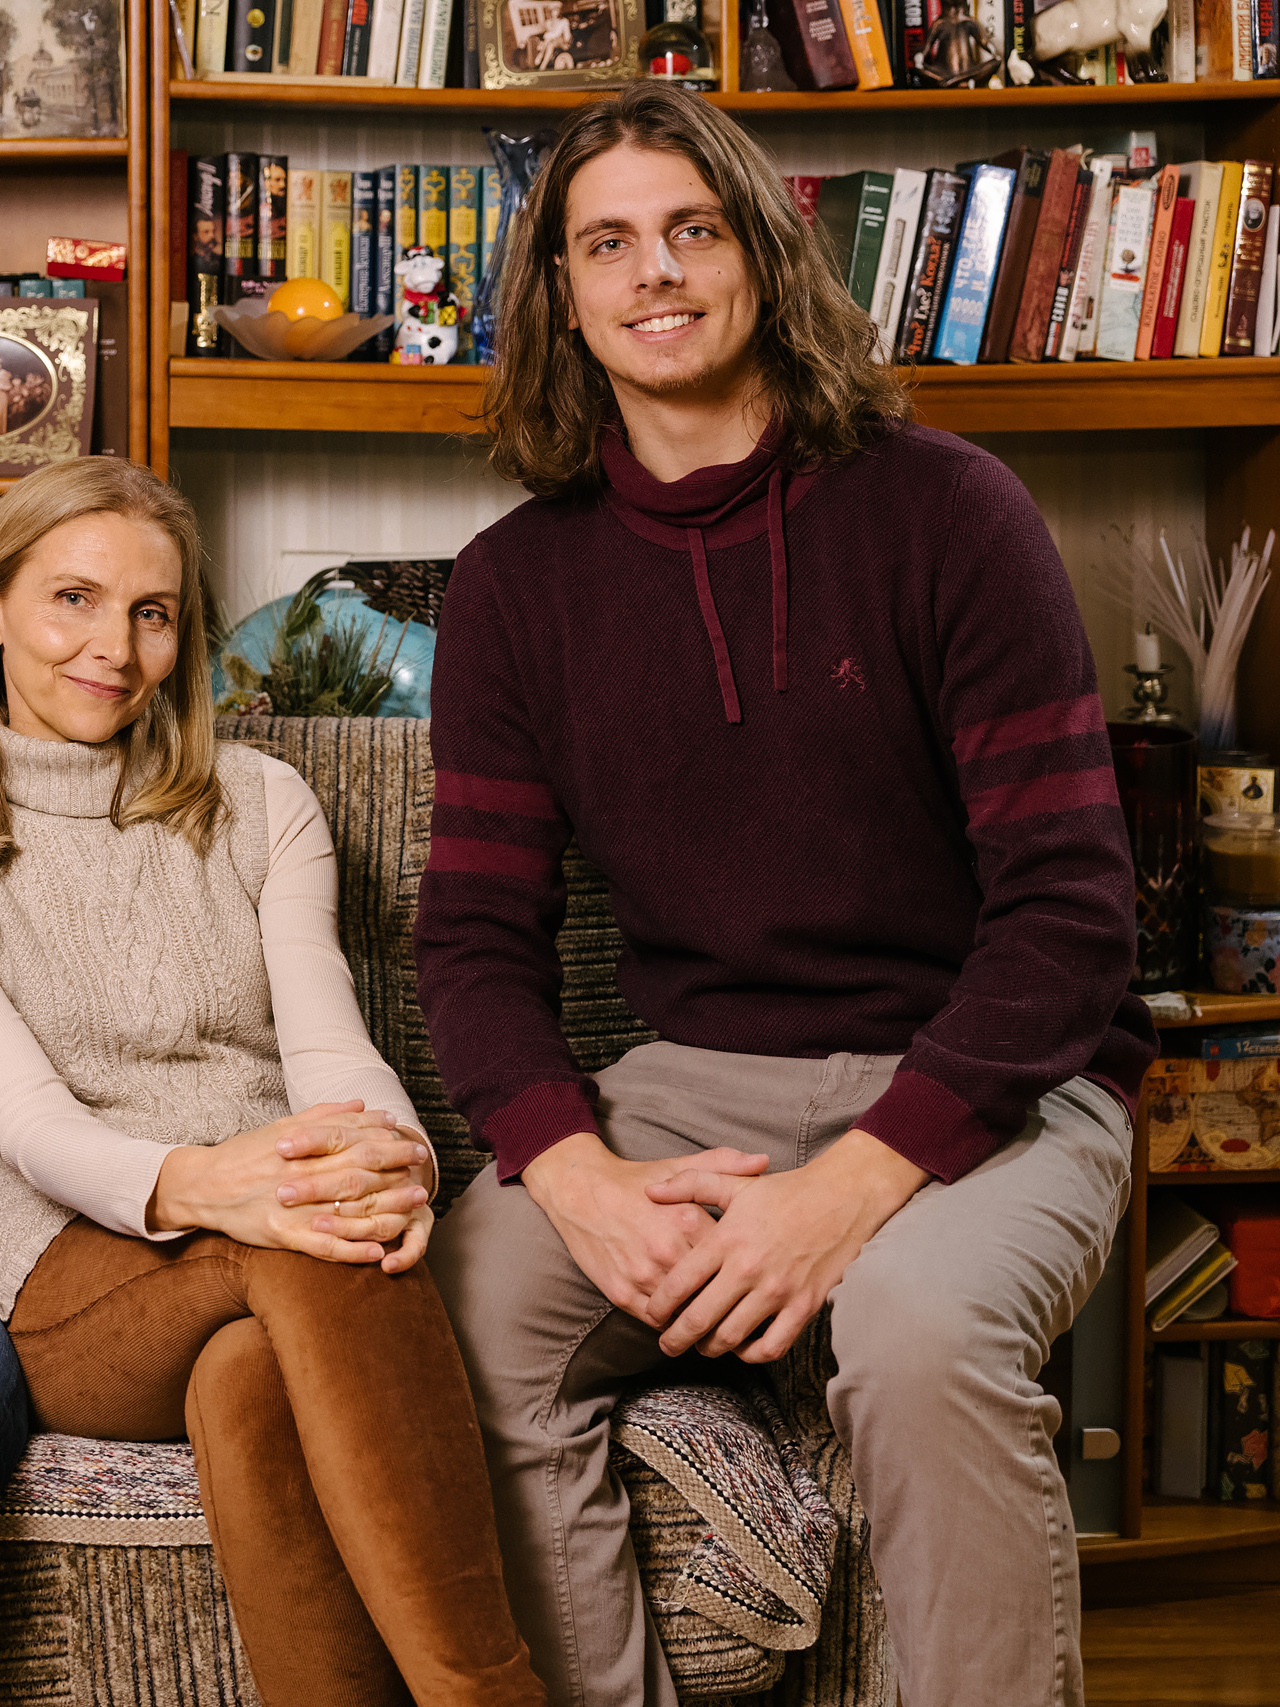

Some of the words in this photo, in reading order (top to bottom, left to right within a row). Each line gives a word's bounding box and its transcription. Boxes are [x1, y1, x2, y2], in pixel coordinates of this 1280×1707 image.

[1238, 14, 1252, 71] ДМИТРИЙ
[920, 236, 941, 287] Когда?
[914, 288, 932, 320] Где?
[908, 321, 926, 355] Что?
